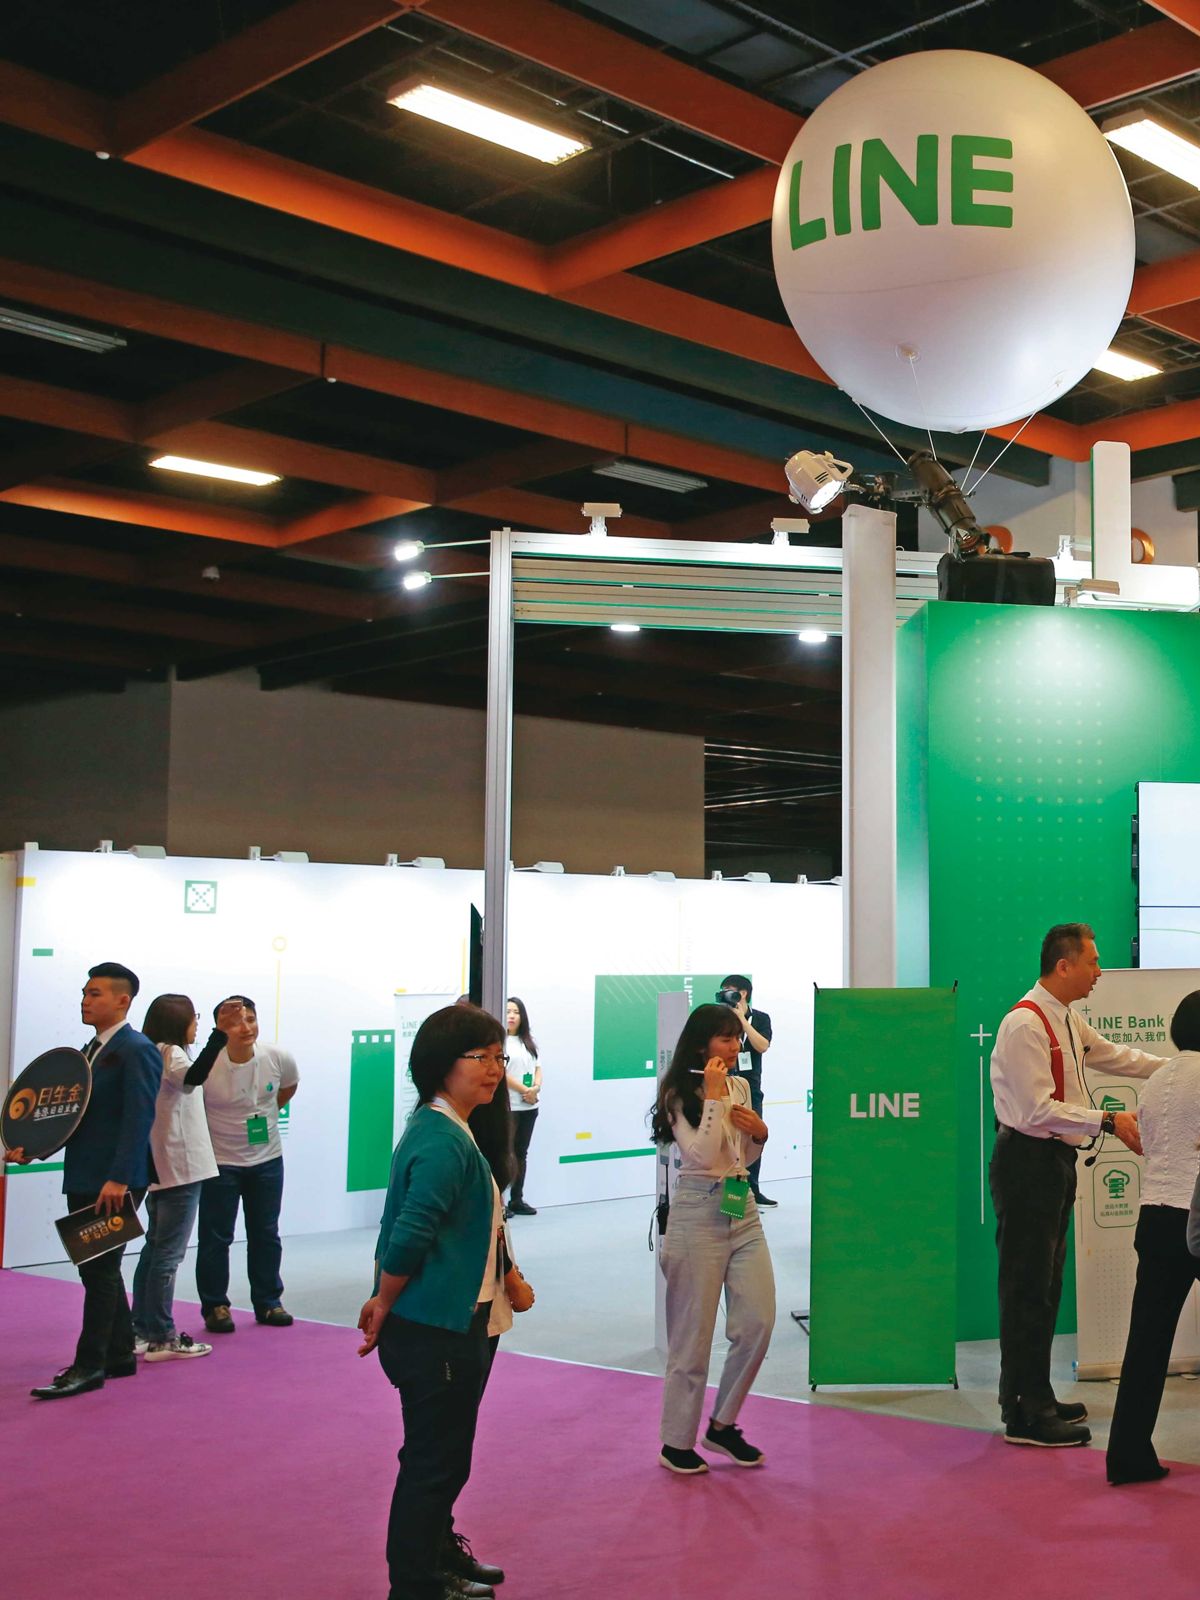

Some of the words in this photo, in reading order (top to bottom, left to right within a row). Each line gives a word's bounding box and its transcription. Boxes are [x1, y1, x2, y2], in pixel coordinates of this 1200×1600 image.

[789, 134, 1014, 250] LINE
[1088, 1016, 1123, 1030] LINE
[1128, 1014, 1165, 1029] Bank
[850, 1092, 920, 1118] LINE
